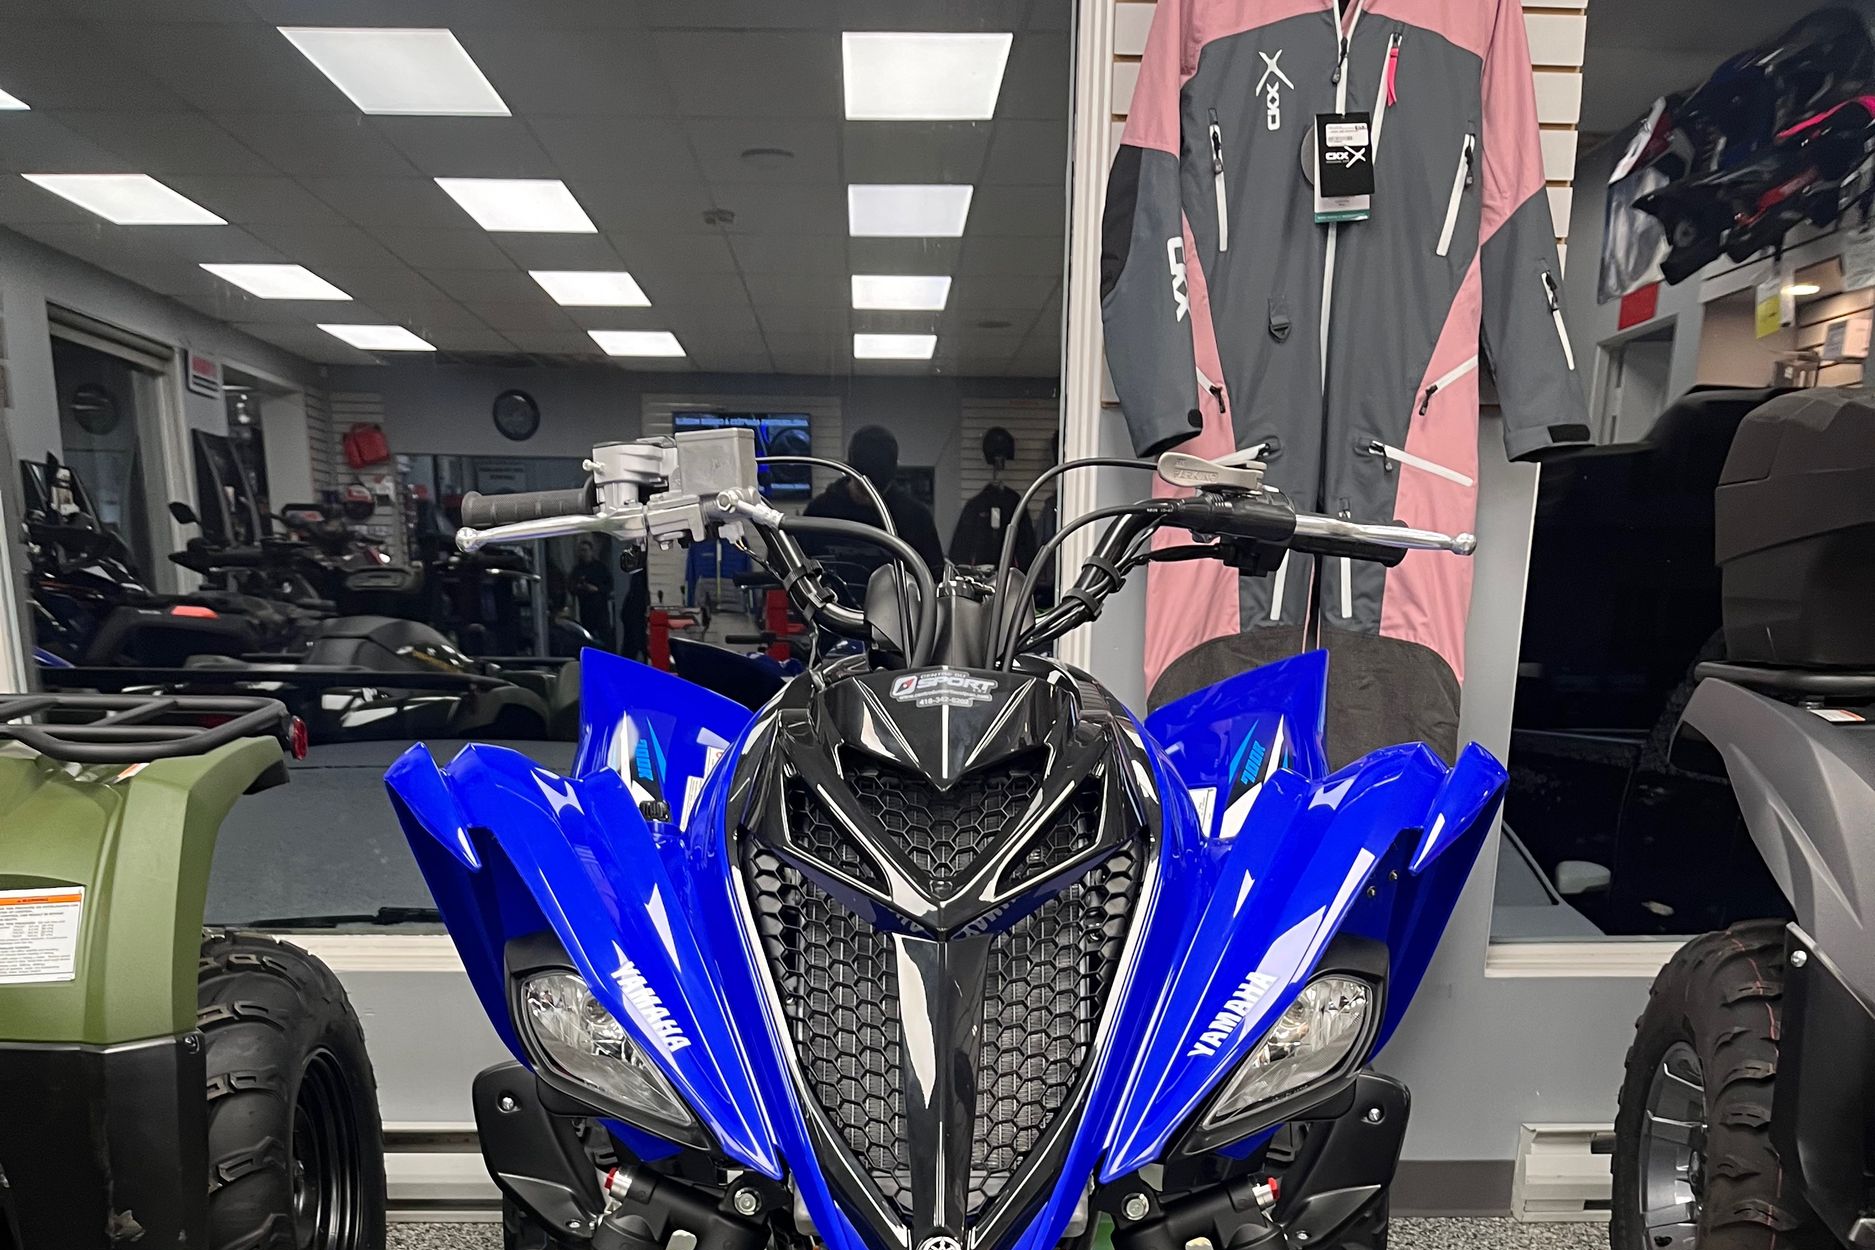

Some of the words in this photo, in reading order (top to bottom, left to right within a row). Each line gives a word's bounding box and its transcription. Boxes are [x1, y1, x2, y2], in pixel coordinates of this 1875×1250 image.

[916, 676, 995, 692] SPORT
[611, 960, 692, 1053] YAMAHA
[1187, 971, 1280, 1057] YAMAHA
